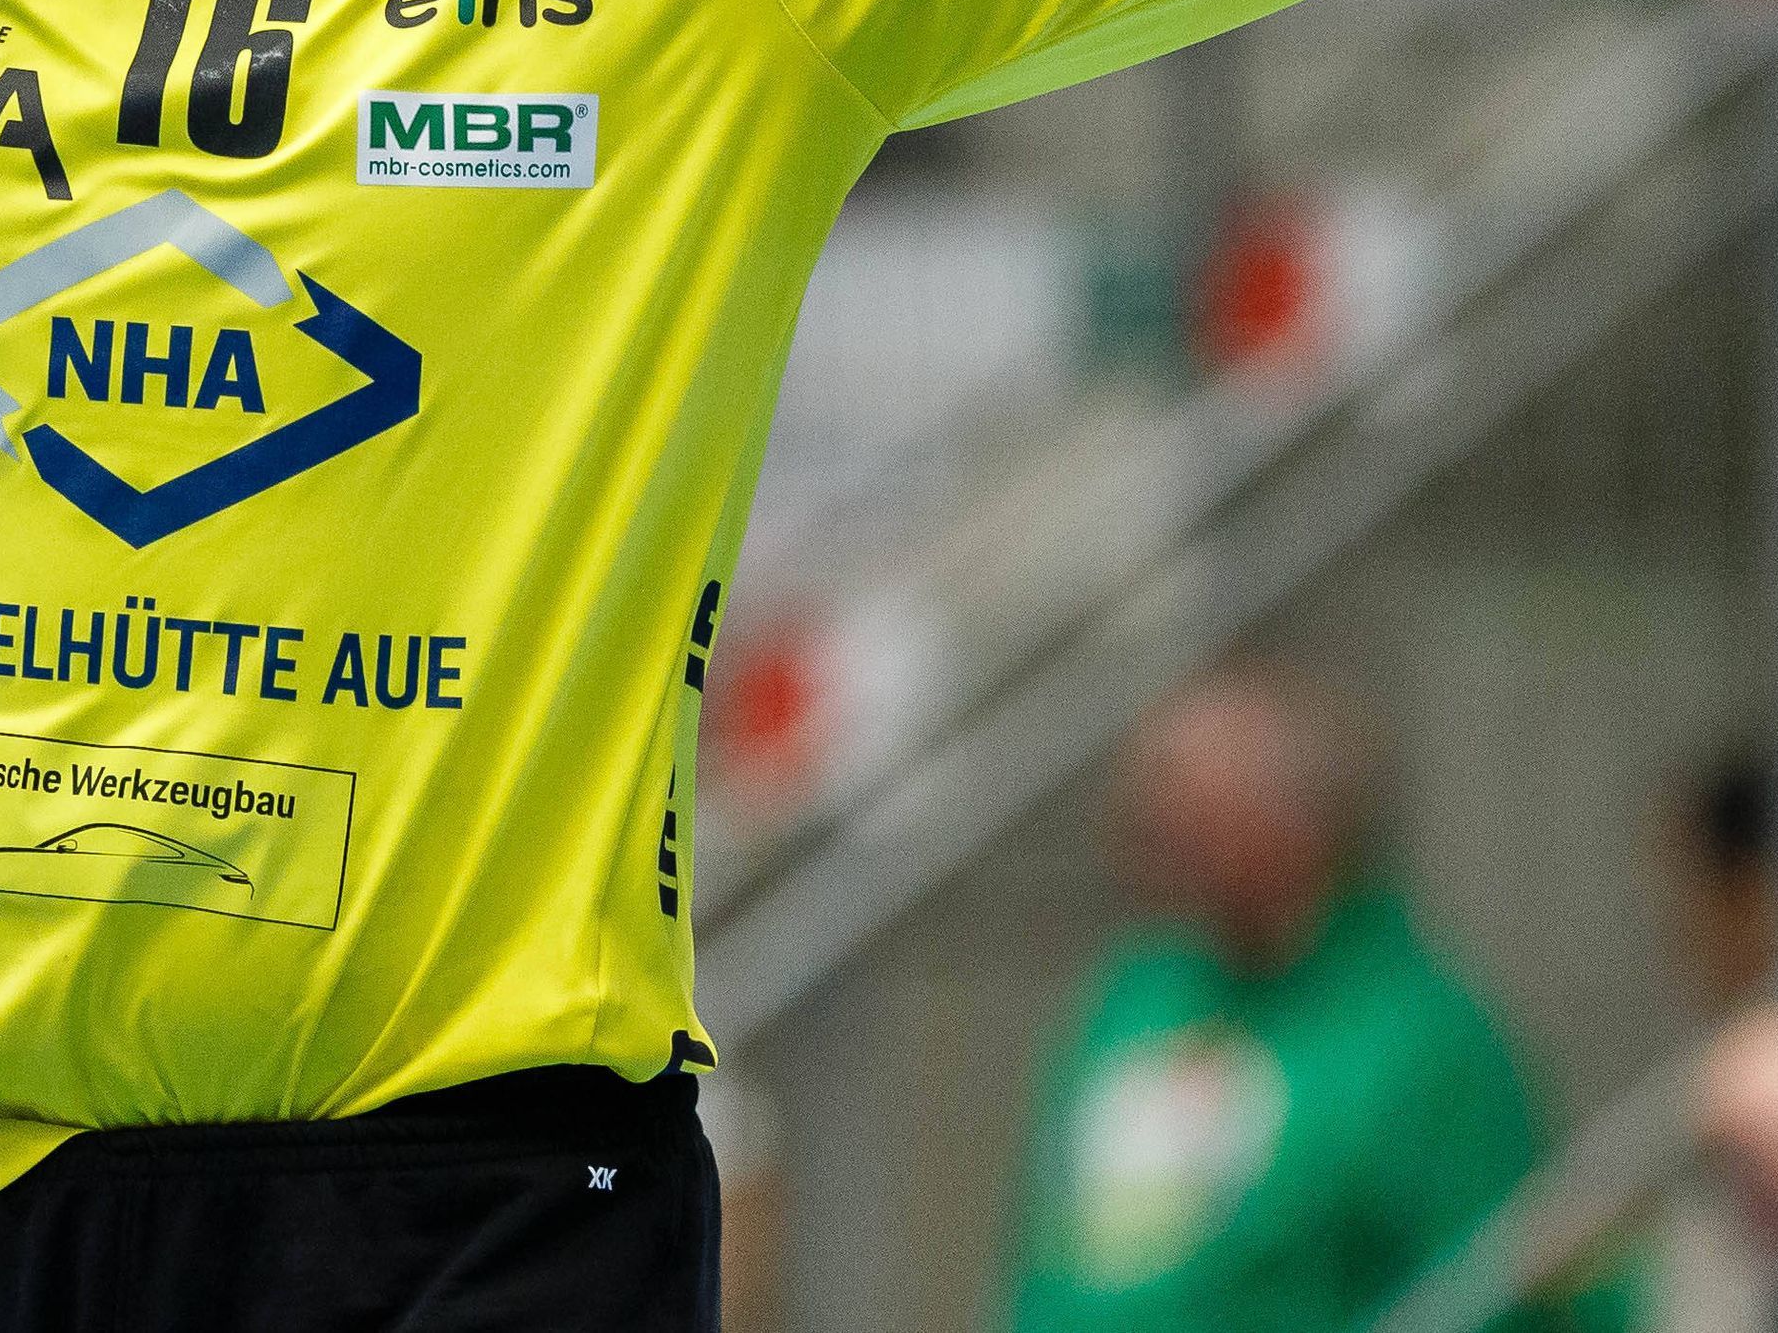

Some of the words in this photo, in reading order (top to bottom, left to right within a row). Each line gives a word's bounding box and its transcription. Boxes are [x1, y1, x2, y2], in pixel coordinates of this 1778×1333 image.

[369, 157, 570, 179] mbr-cosmetics.com
[46, 316, 266, 414] NHA
[322, 632, 467, 710] AUE
[71, 763, 296, 820] Werkzeugbau
